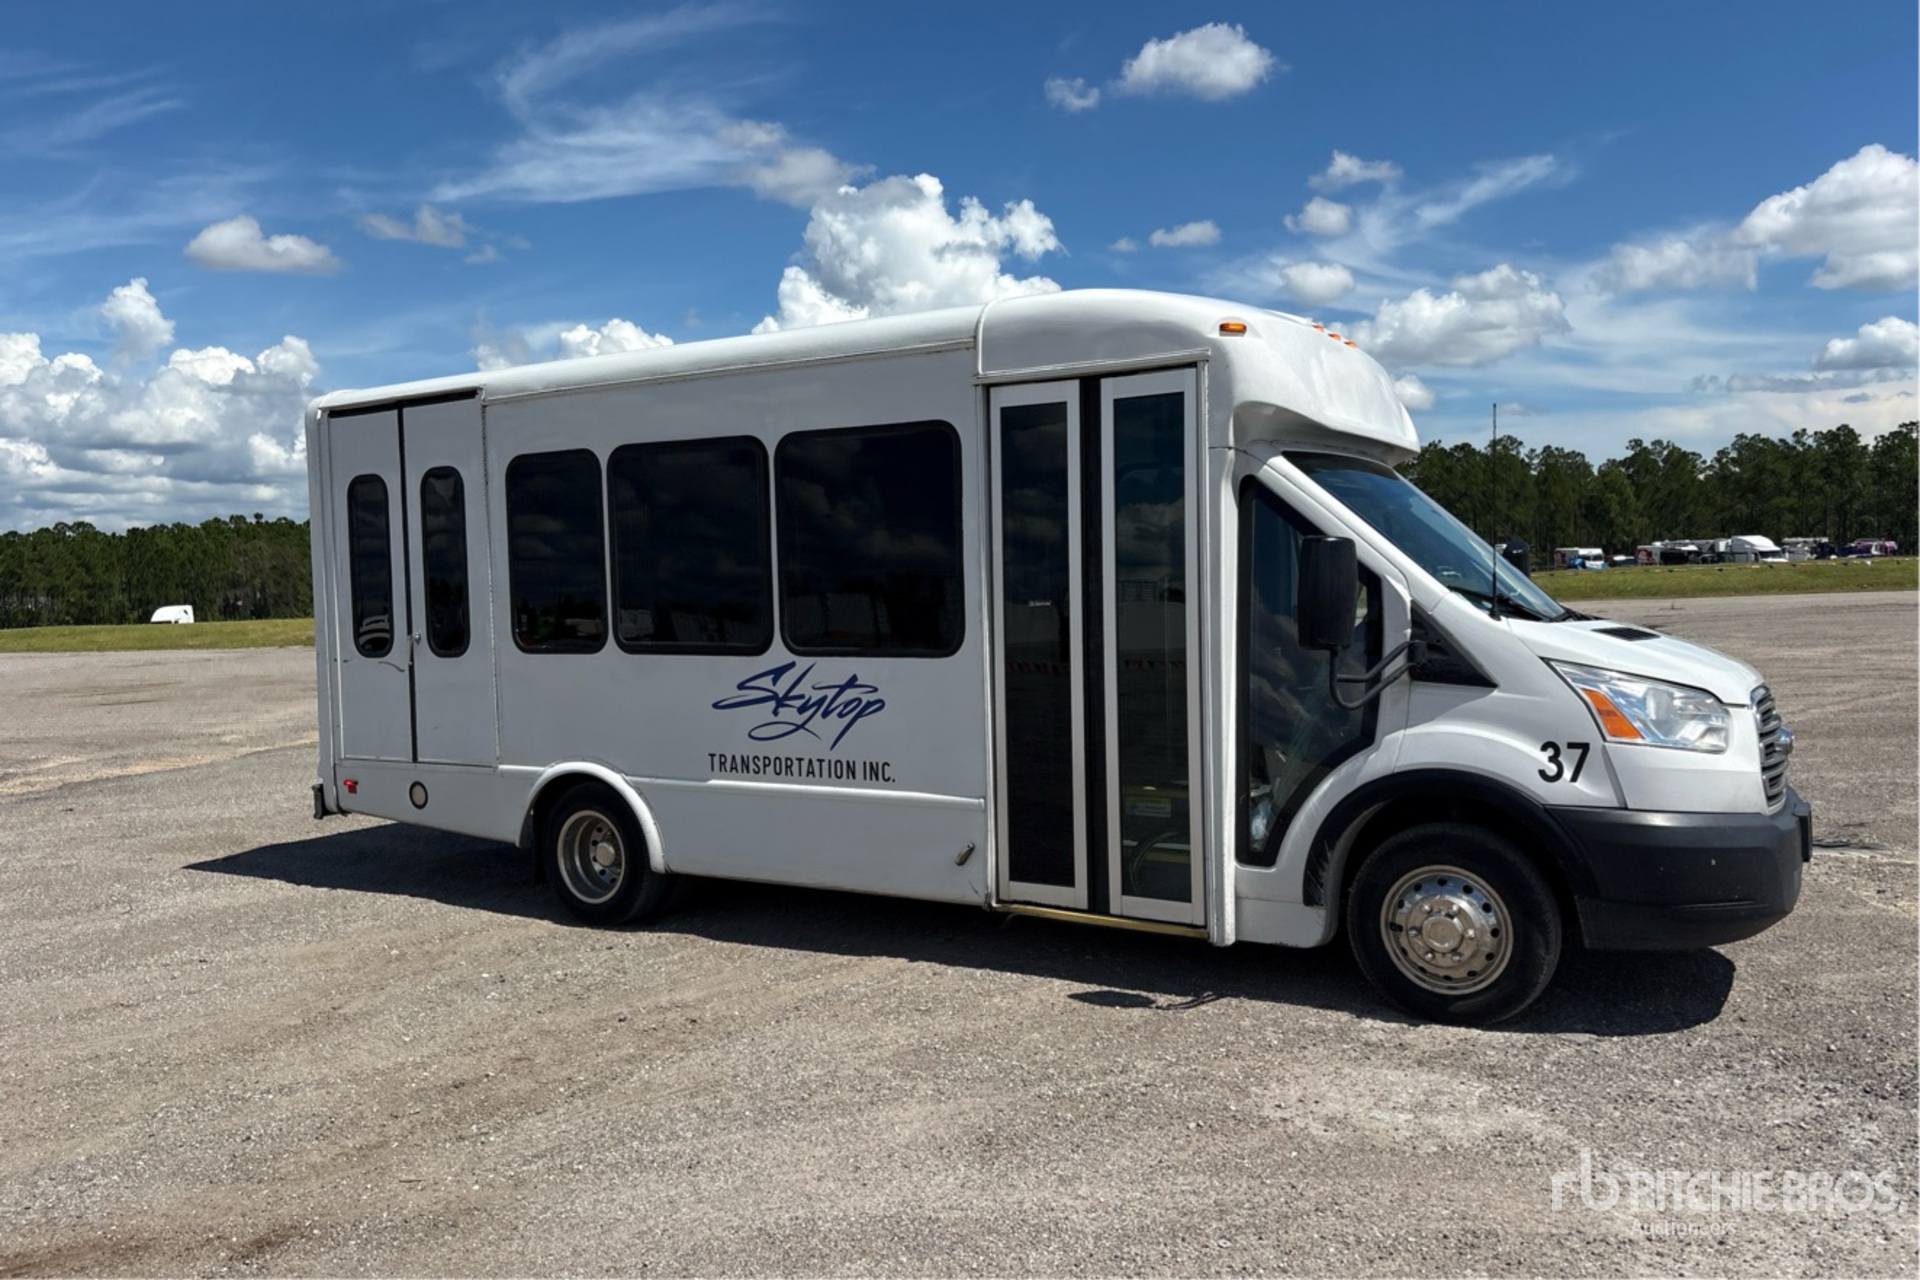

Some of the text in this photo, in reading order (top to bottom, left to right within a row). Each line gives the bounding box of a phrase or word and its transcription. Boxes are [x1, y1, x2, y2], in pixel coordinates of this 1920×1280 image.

[712, 661, 885, 751] Skytop
[708, 753, 896, 782] TRANSPORTATION INC.
[1538, 741, 1590, 783] 37
